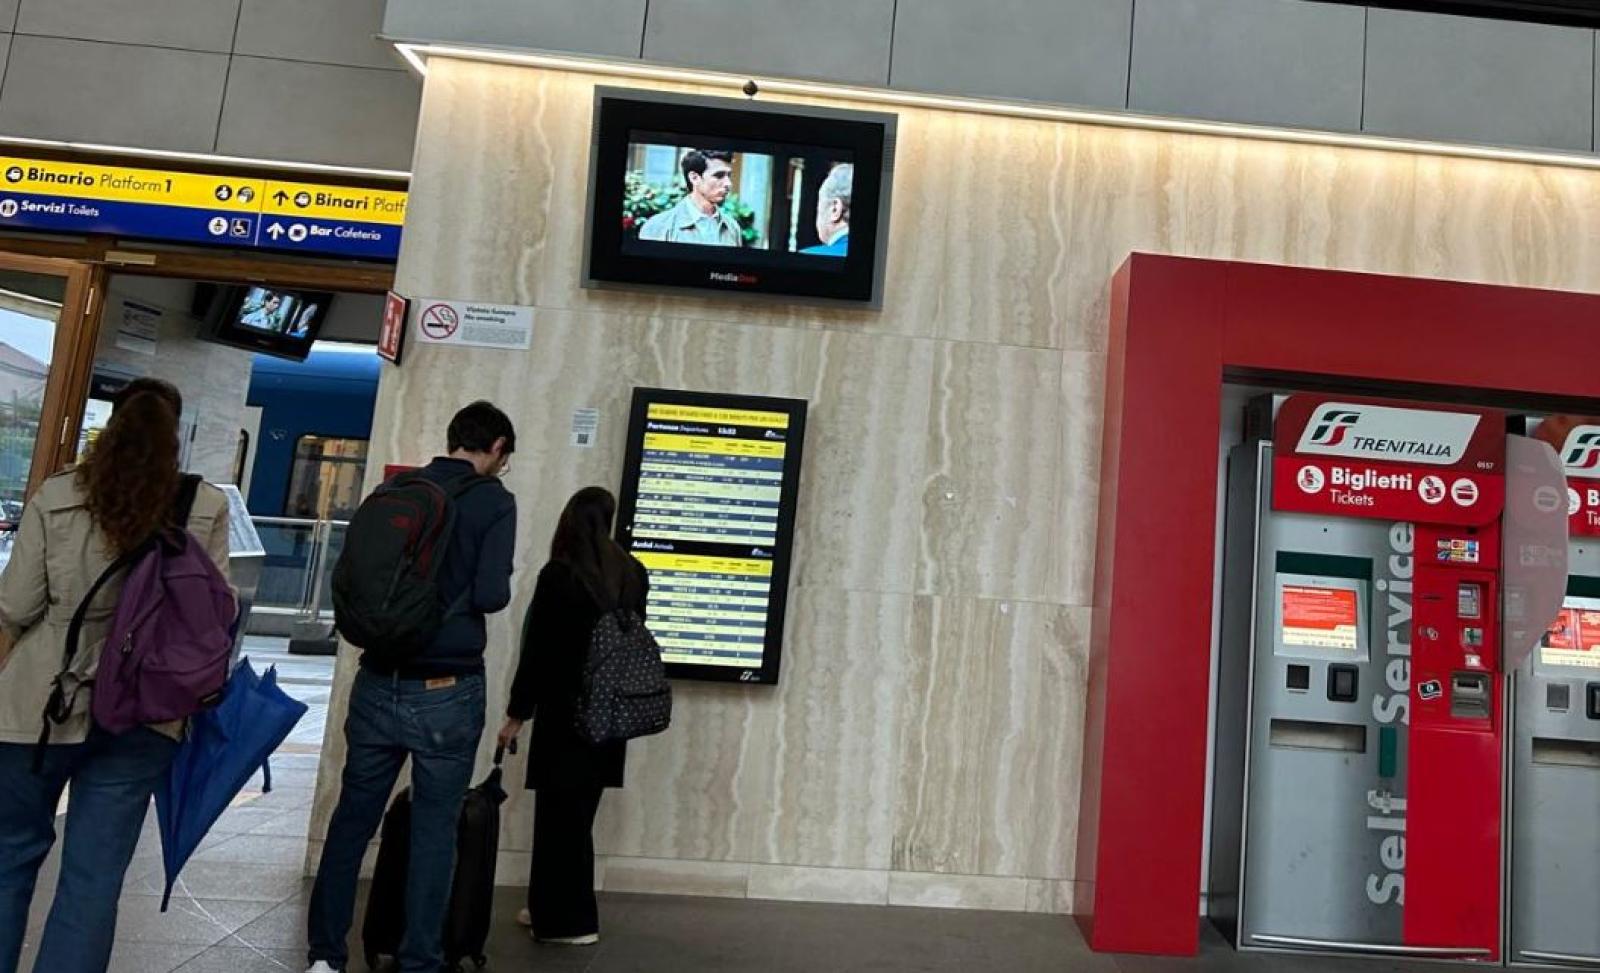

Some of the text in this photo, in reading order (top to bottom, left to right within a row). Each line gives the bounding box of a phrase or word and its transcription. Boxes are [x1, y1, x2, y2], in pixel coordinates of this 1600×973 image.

[27, 167, 172, 193] Binario Platform 1
[20, 200, 100, 218] Servizi Toilets
[314, 193, 369, 210] Binari
[309, 225, 382, 241] Bar Cafeteria
[1352, 436, 1452, 458] TRENITALIA
[1331, 466, 1413, 491] Biglietti
[1329, 487, 1375, 506] Tickets
